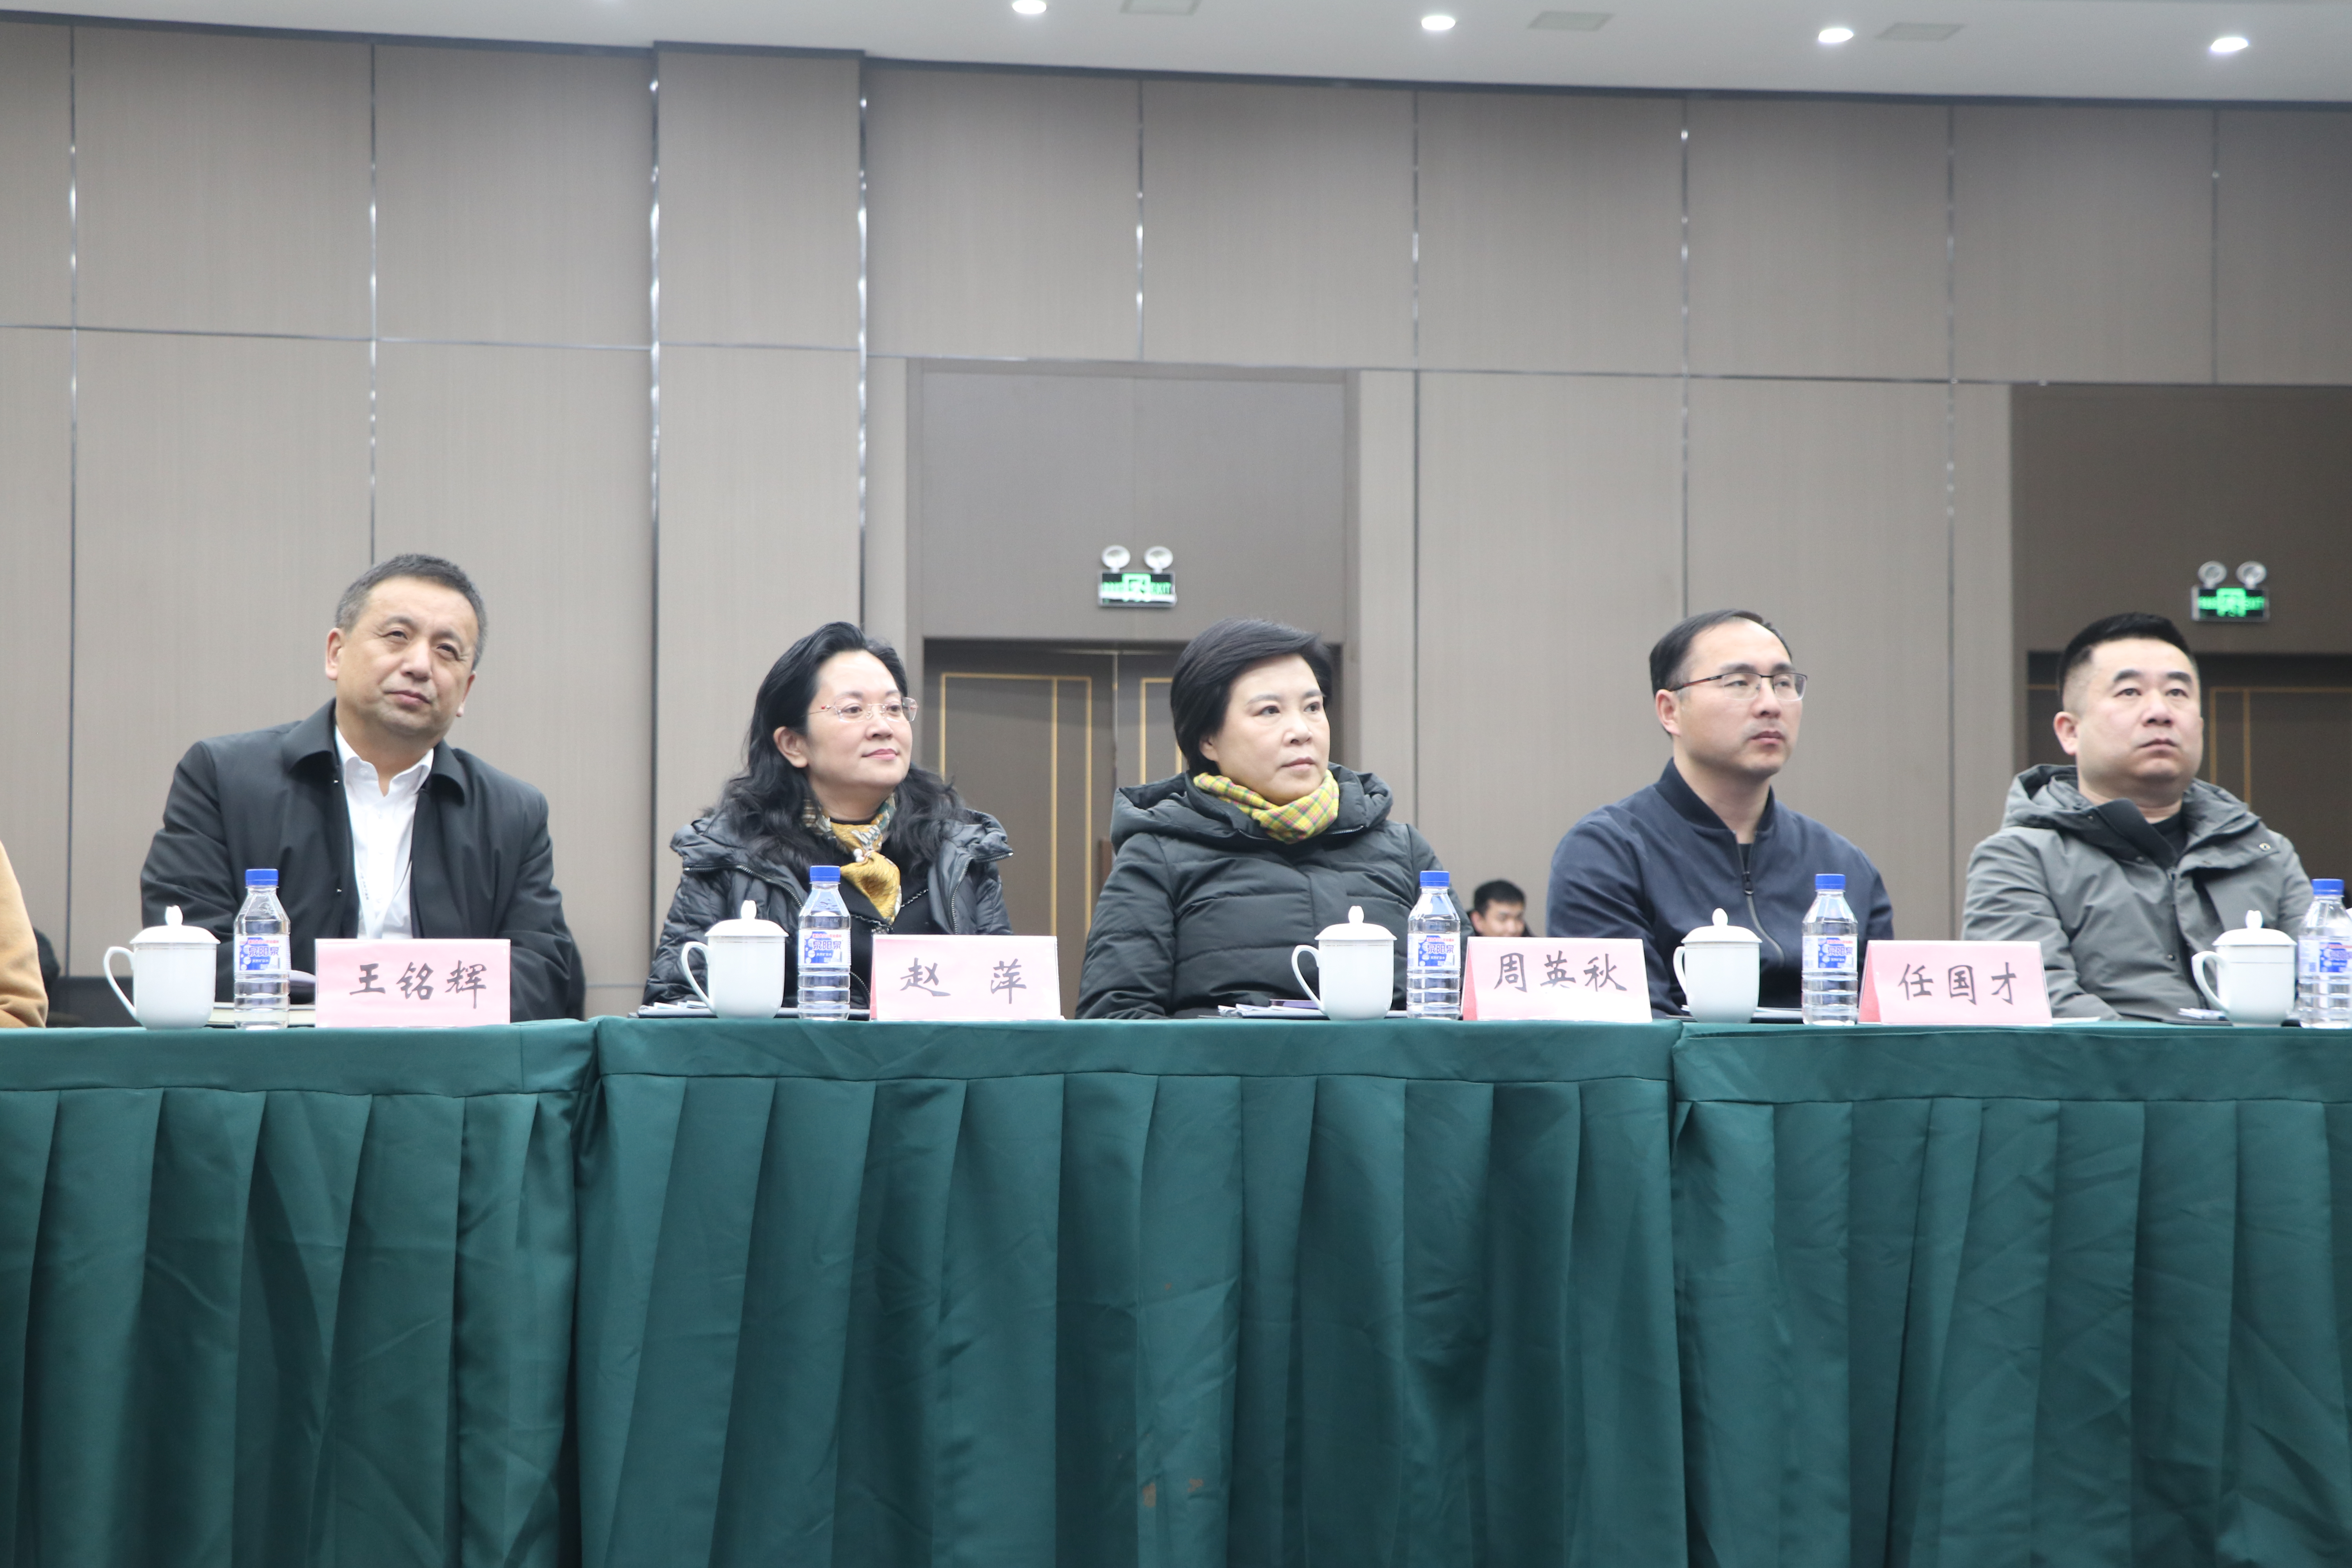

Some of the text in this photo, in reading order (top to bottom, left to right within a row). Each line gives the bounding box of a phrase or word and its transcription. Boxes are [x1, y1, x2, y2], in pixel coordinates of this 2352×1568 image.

[249, 946, 279, 956] 泉阳泉
[813, 940, 841, 950] 泉阳泉
[1427, 944, 1454, 954] 泉阳泉
[350, 960, 486, 1009] 王铭辉
[900, 958, 1027, 1004] 赵 萍
[1494, 950, 1627, 992] 周英秋
[1898, 962, 2016, 1005] 任国才
